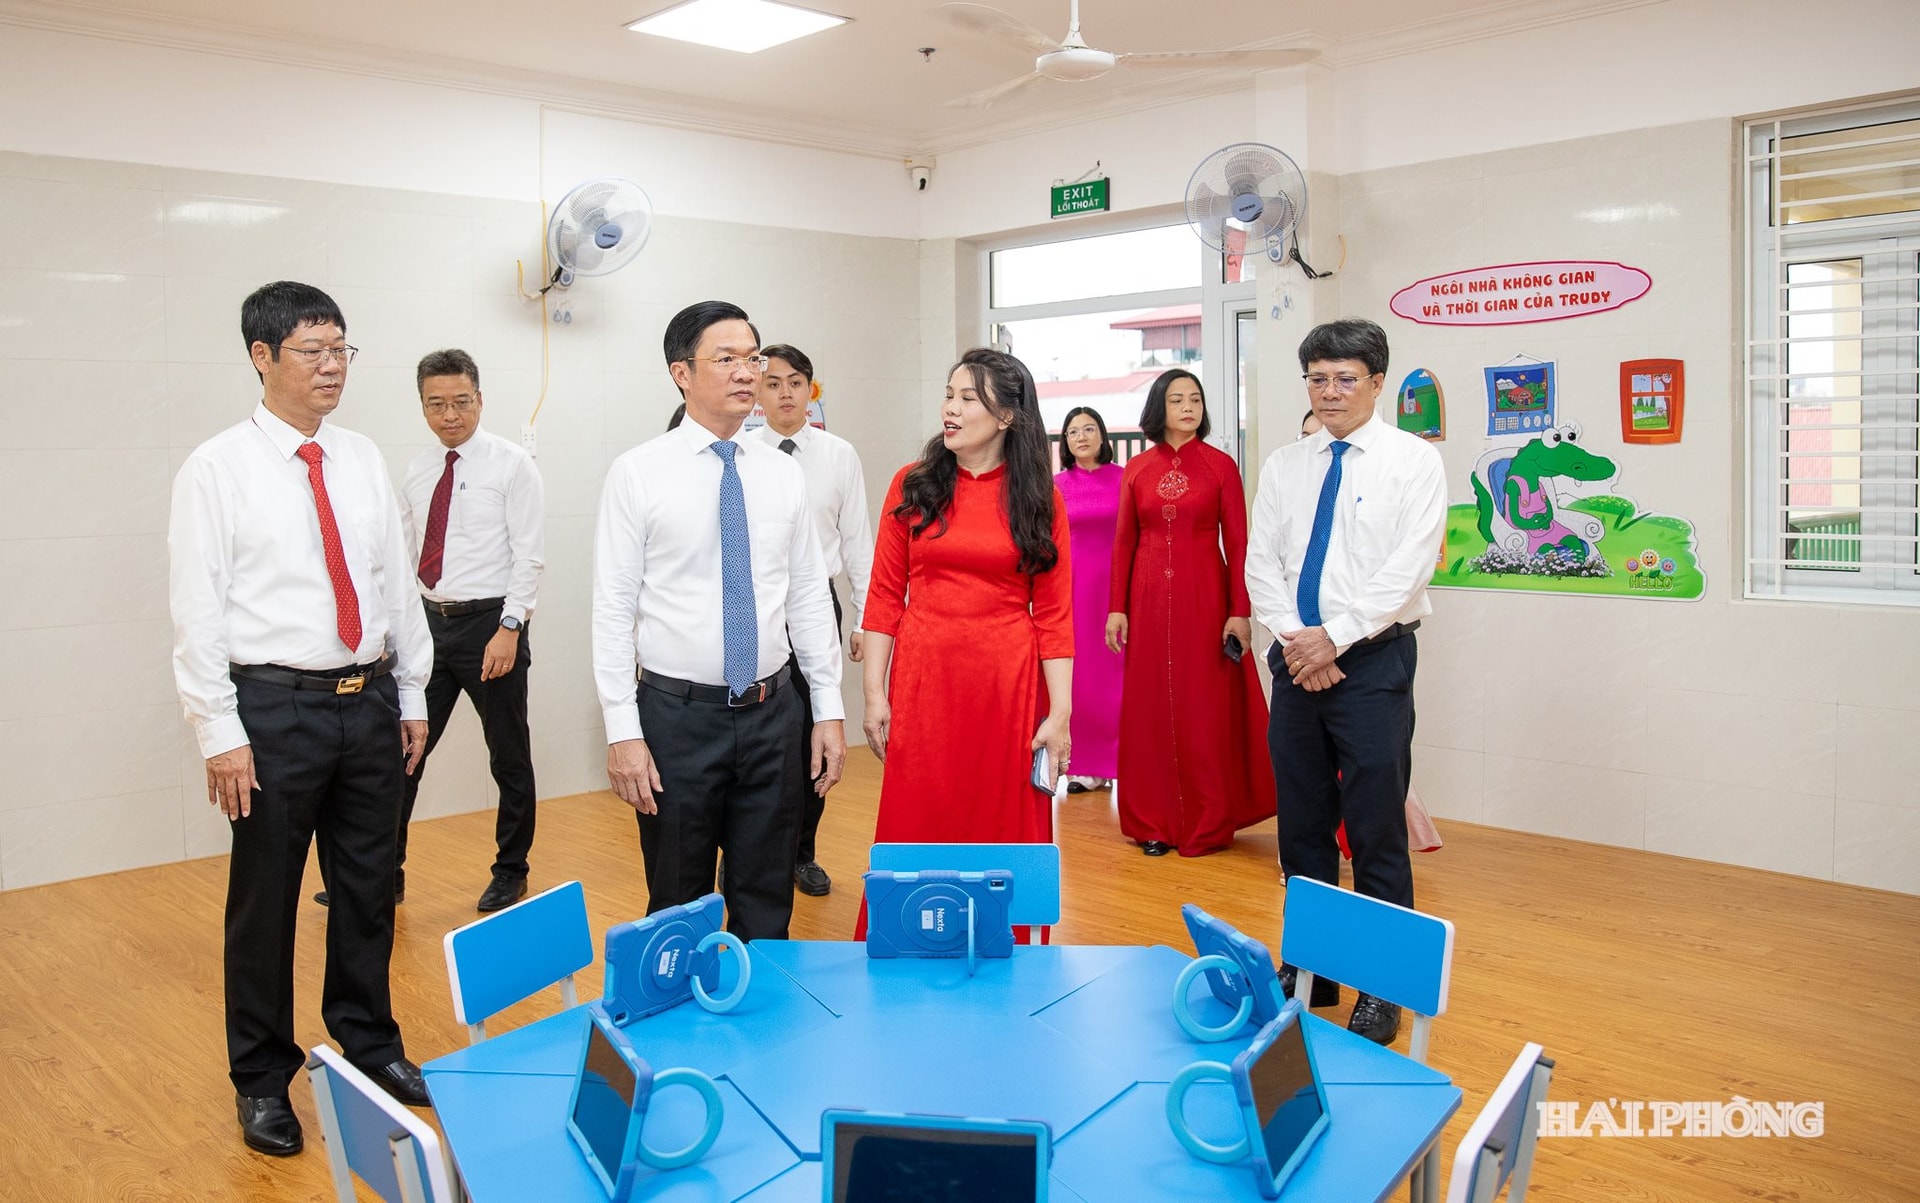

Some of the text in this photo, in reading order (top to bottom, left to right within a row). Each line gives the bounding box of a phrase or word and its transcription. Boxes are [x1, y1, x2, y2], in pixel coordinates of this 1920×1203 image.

[1063, 185, 1093, 200] EXIT
[1058, 197, 1100, 213] LỐI THOÁT
[1431, 270, 1594, 296] NGÔI NHÀ KHÔNG GIAN
[1422, 290, 1610, 316] VÀ THỜI GIAN CỦA TRUDY
[1629, 575, 1673, 590] HELLO
